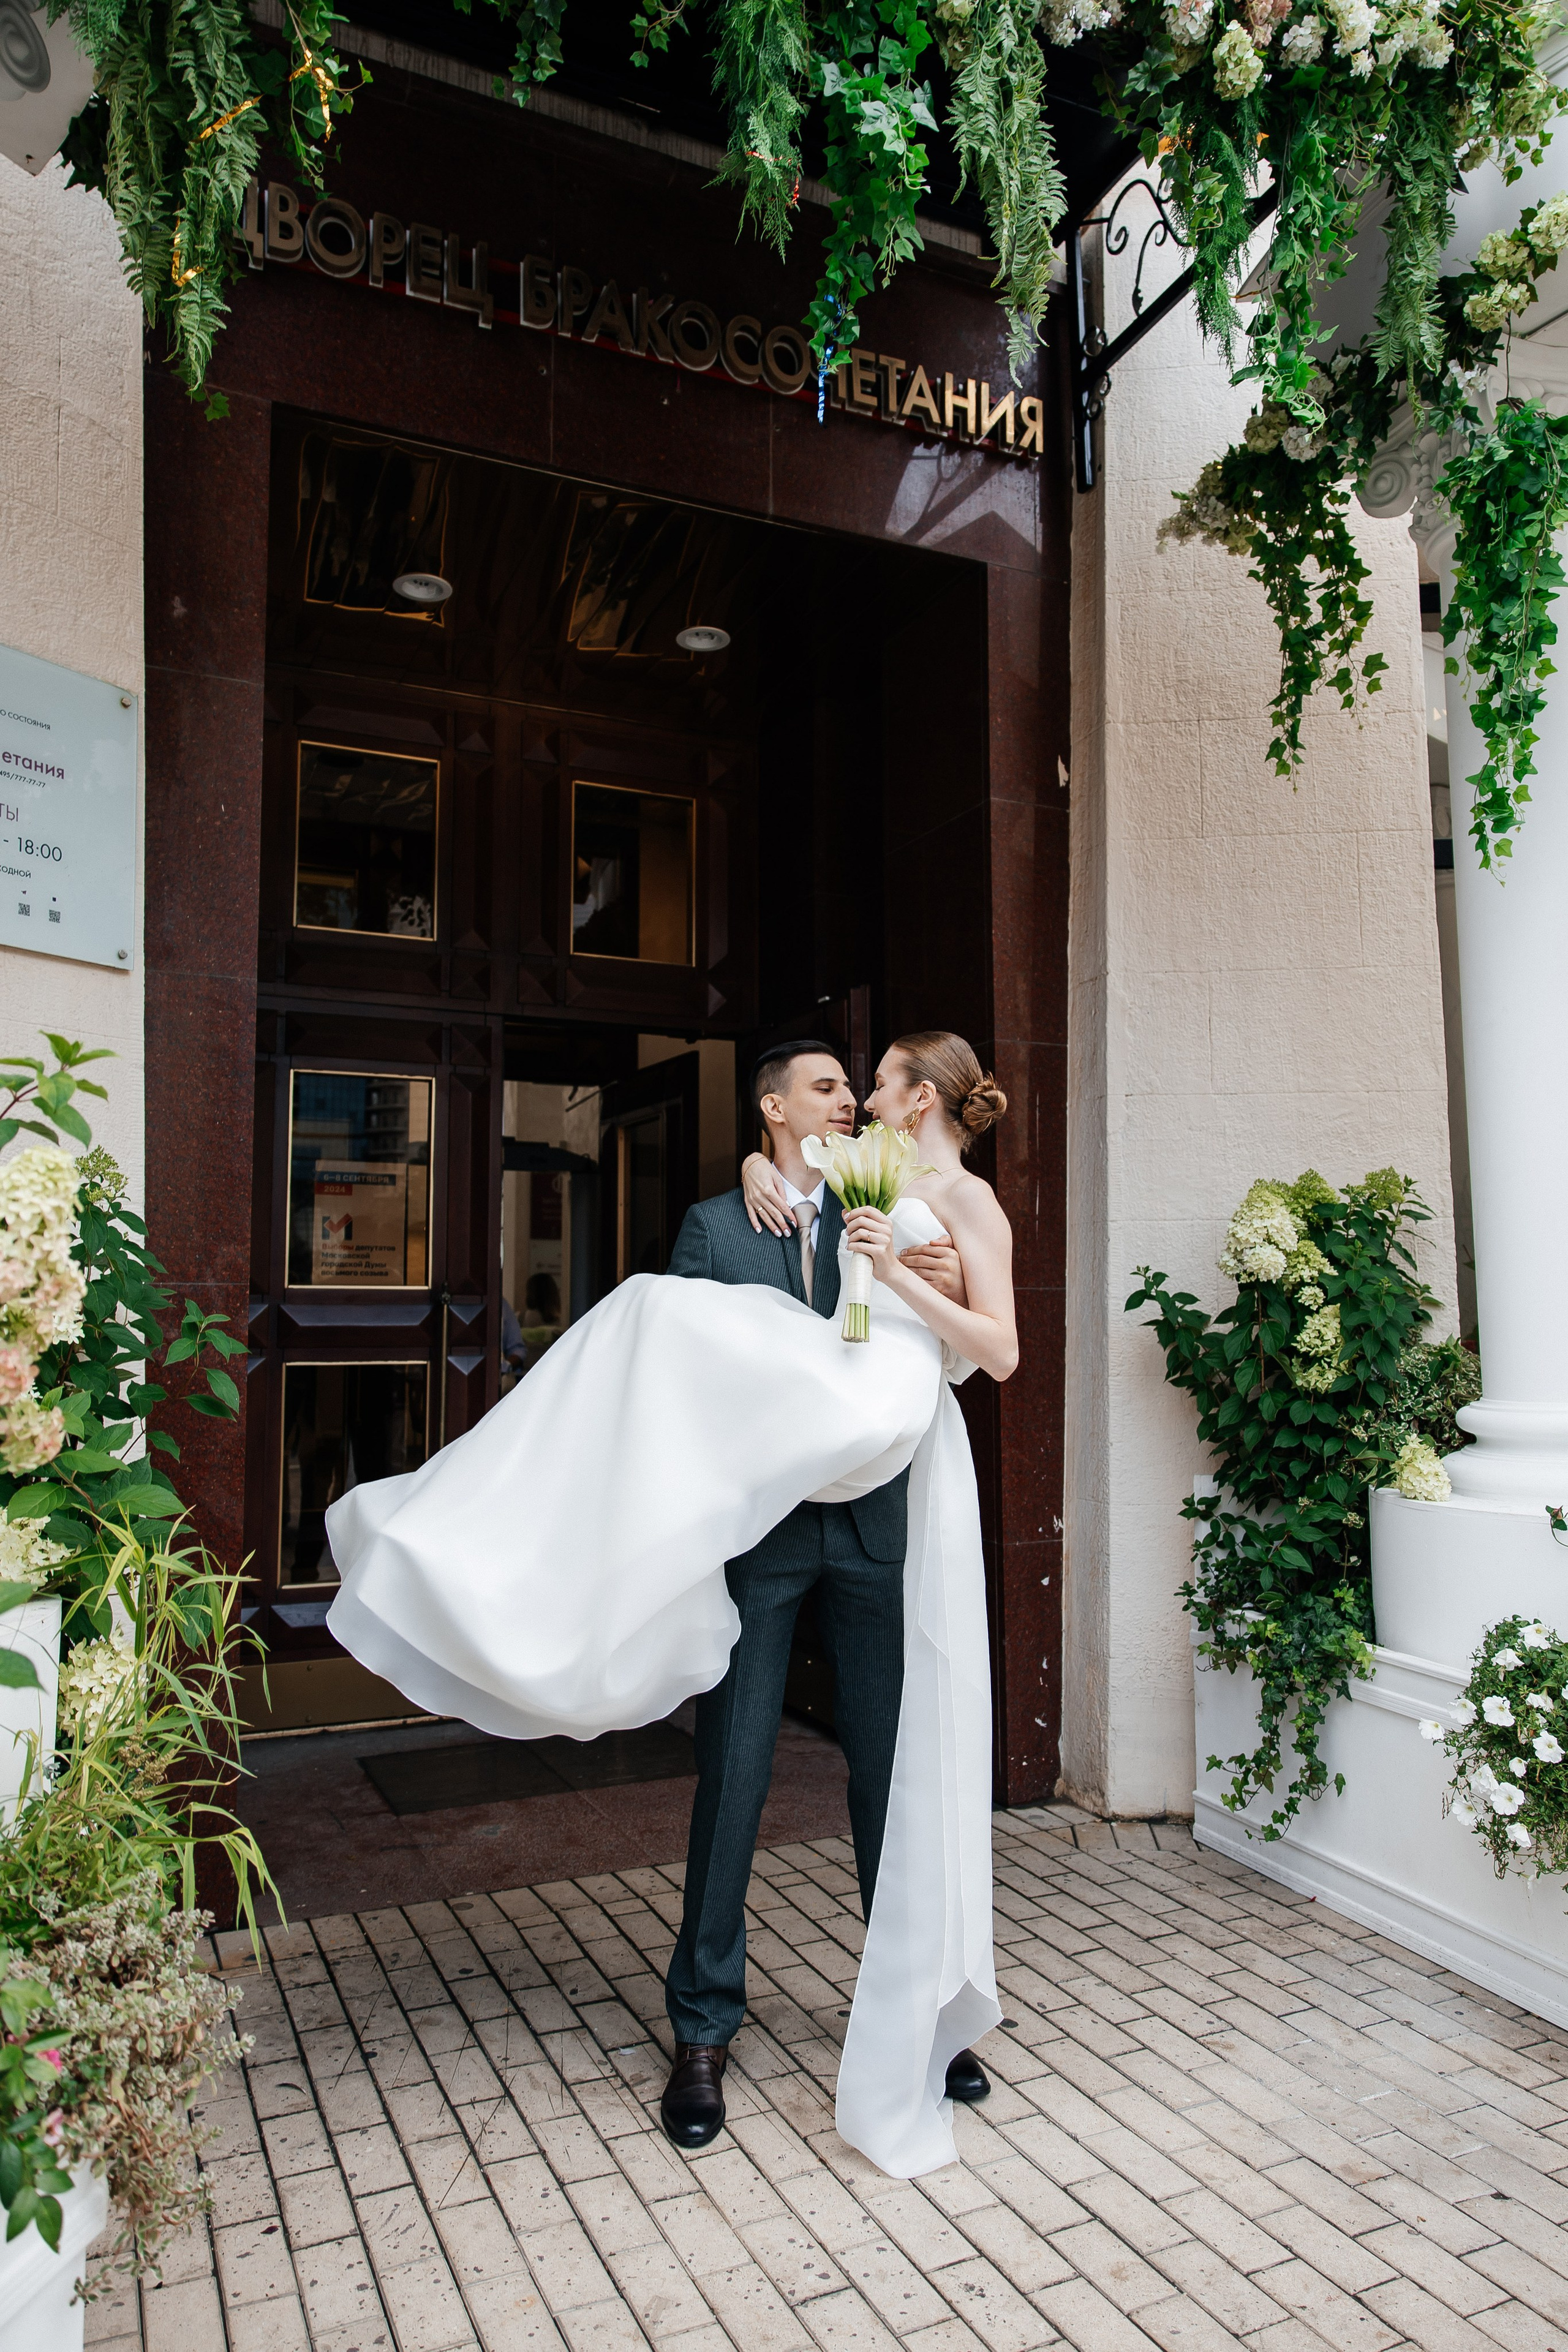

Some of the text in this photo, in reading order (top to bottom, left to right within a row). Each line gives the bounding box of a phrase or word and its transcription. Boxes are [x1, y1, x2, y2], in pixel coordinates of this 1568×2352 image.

[2, 752, 64, 779] етания
[18, 837, 62, 862] 18:00
[342, 1174, 389, 1183] СЕНТЯБРЯ
